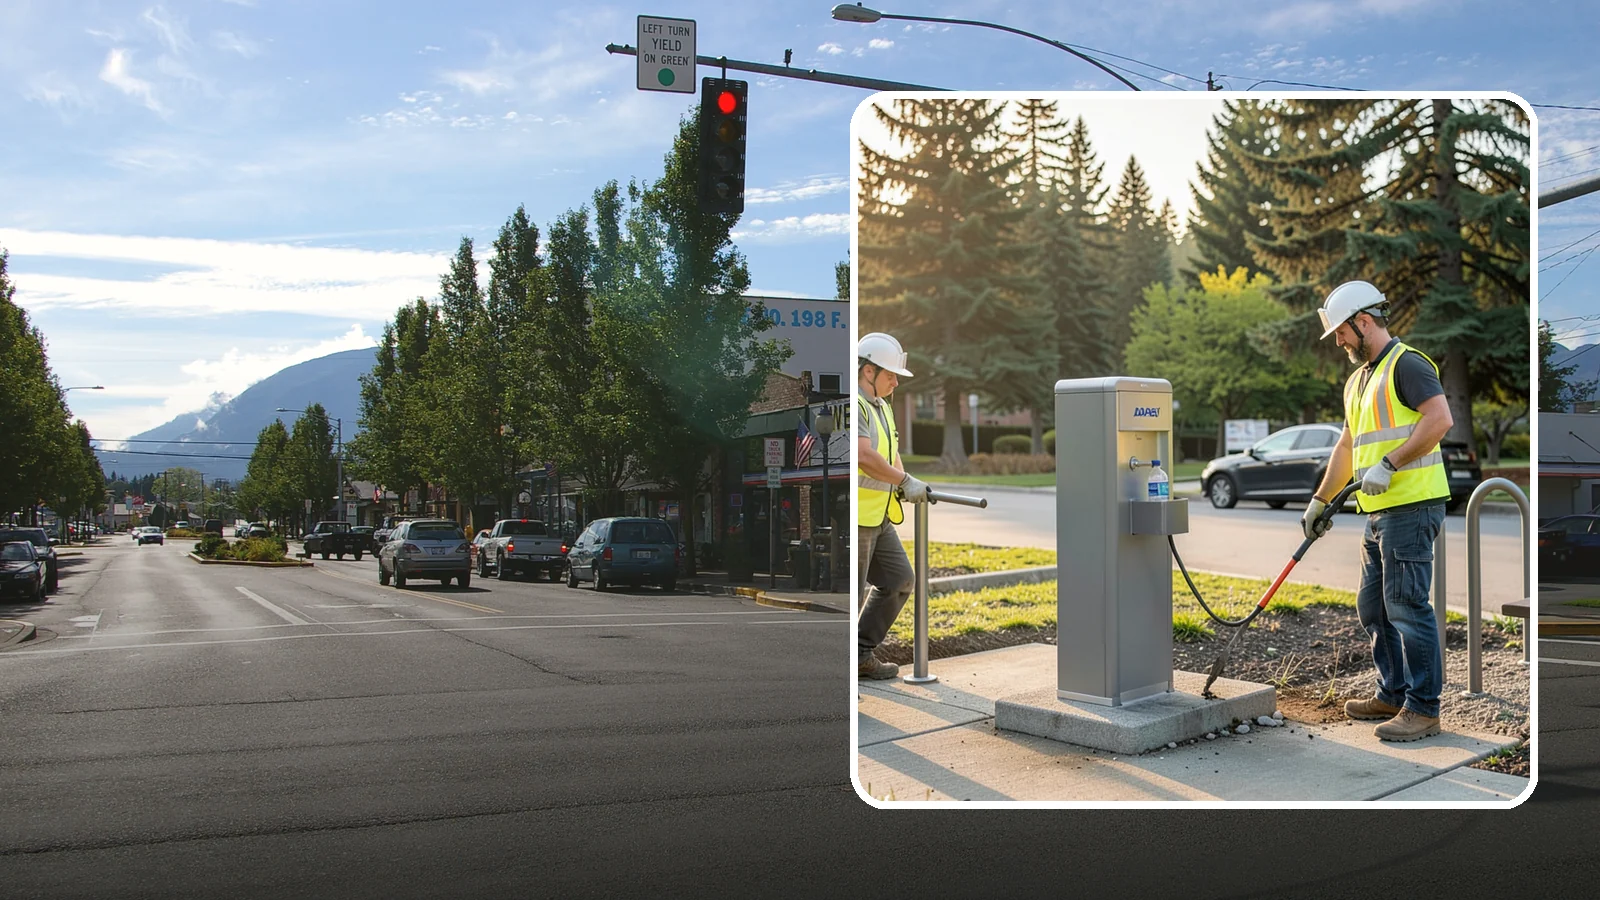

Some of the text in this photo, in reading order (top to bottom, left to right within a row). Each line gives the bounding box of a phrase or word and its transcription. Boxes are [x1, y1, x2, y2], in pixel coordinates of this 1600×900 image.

[643, 24, 690, 37] LEFT TURN
[652, 38, 682, 52] YIELD
[644, 53, 689, 66] ON GREEN
[791, 309, 826, 328] 198
[831, 311, 846, 329] F.
